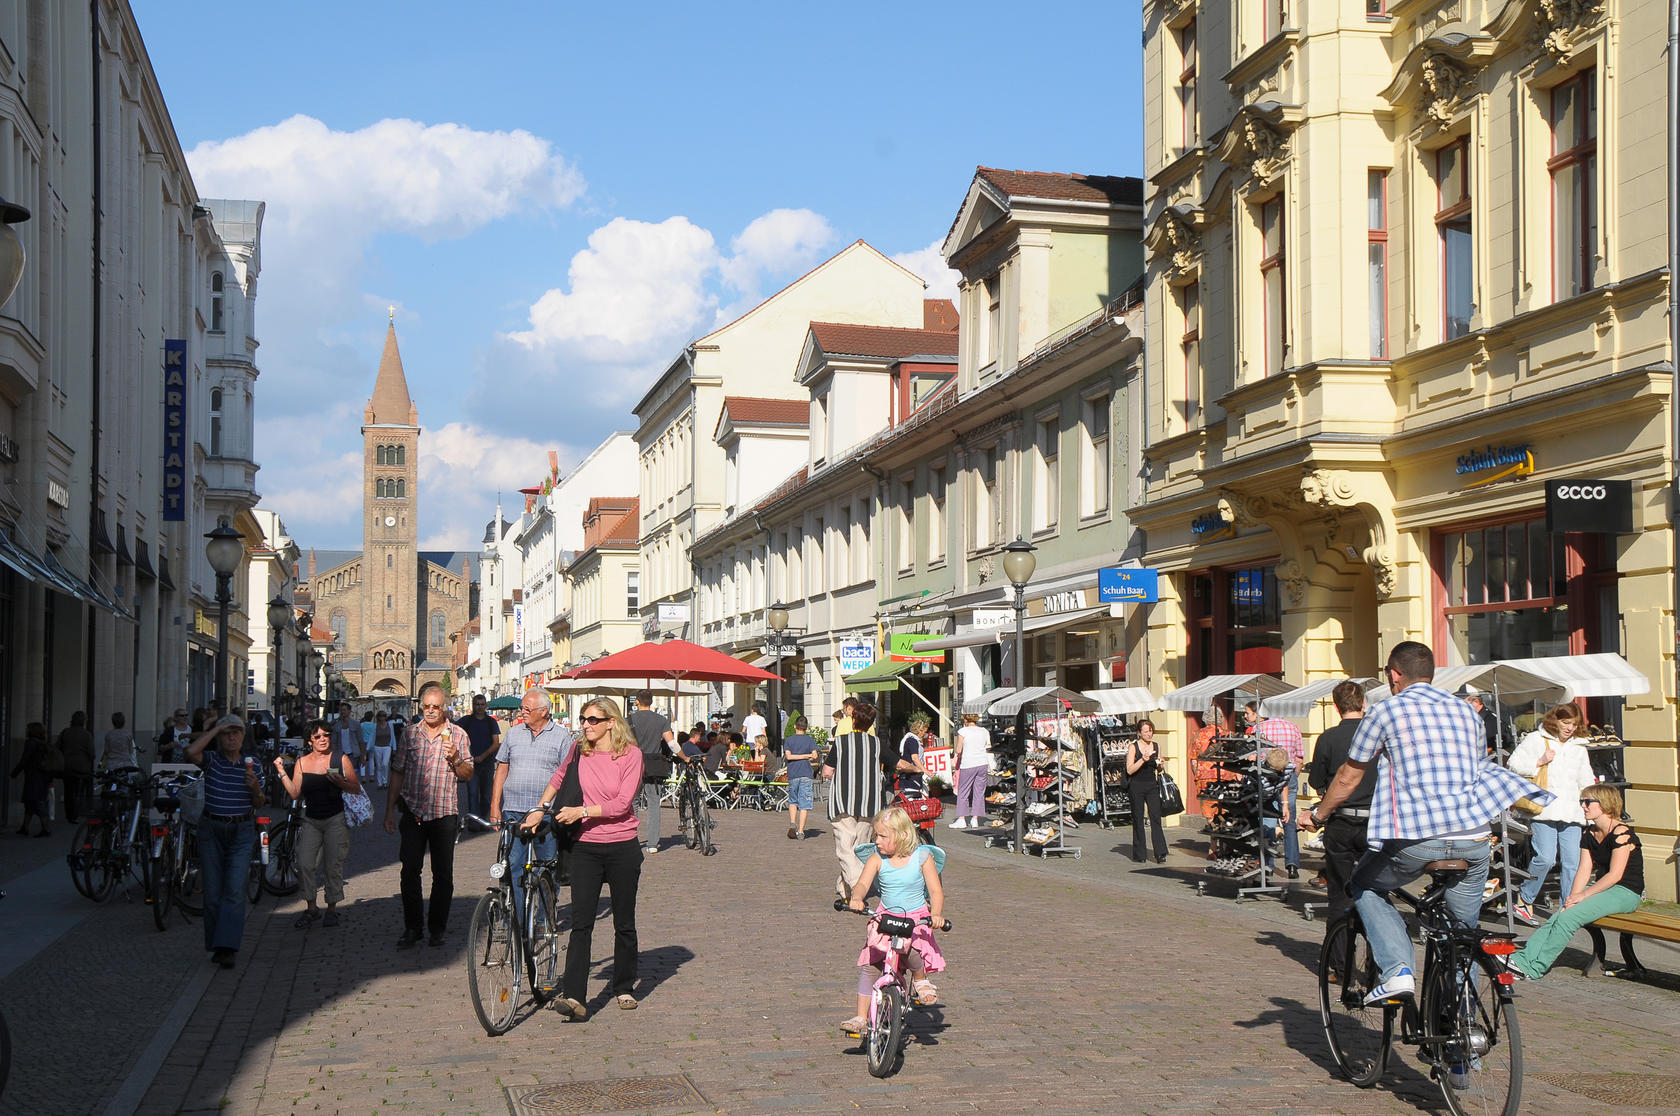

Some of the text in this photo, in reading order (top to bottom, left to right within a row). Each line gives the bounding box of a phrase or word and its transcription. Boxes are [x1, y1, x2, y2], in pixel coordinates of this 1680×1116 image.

[166, 350, 184, 509] KARSTADT
[1557, 485, 1606, 500] ecco
[1103, 585, 1144, 595] Schuh Baar
[1043, 590, 1087, 613] BONITA
[976, 613, 1014, 625] BONITA
[843, 647, 871, 657] back
[842, 660, 871, 670] WERK
[925, 754, 946, 772] EIS
[887, 919, 910, 929] PUKY
